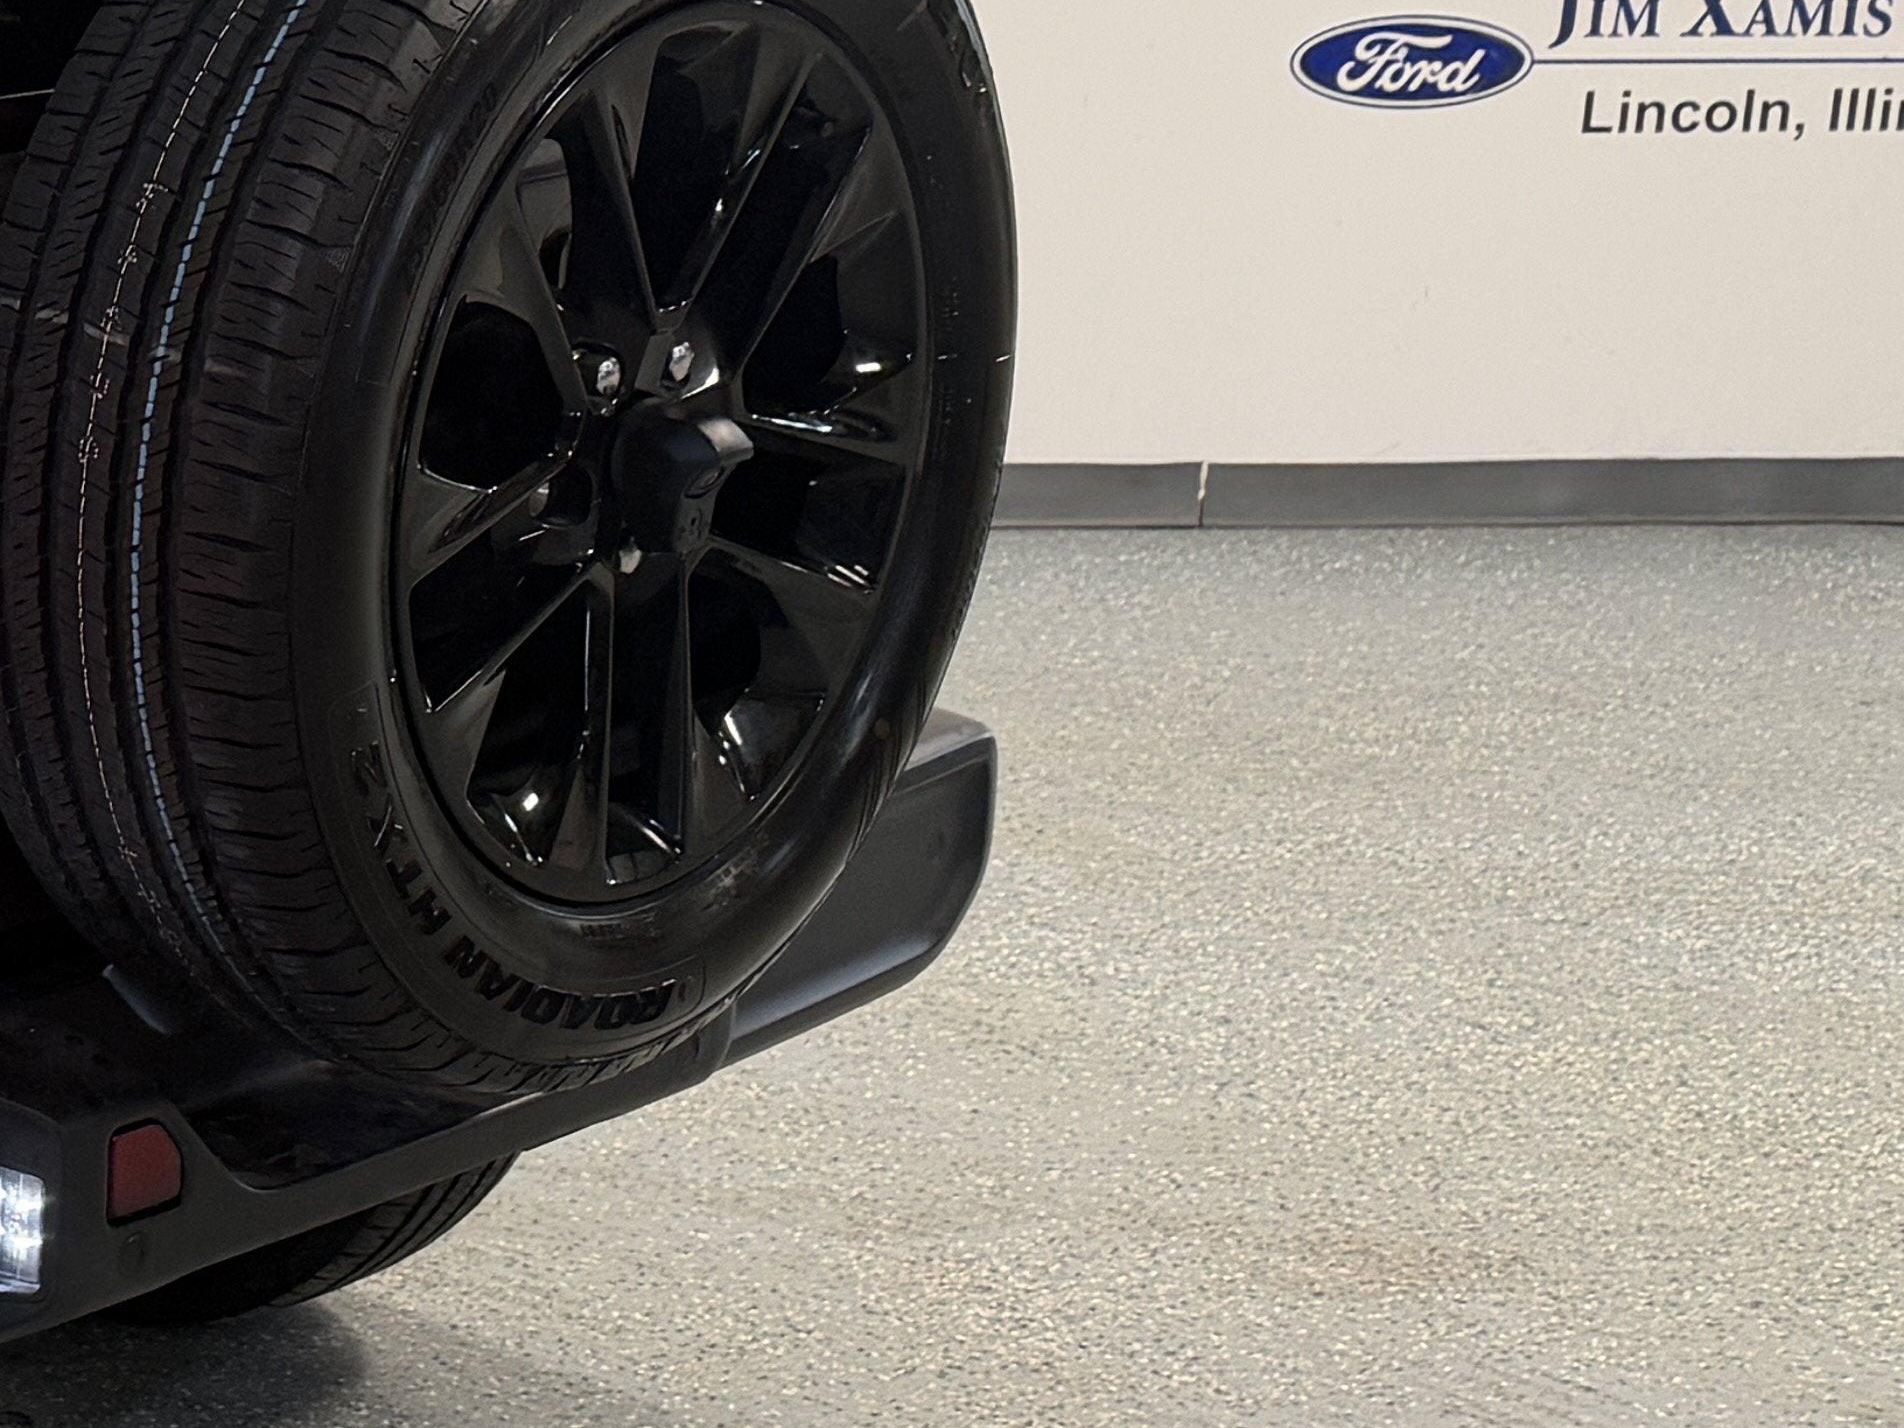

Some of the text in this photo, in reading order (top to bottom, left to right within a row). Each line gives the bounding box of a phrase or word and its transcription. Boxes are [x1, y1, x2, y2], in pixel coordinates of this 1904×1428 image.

[1336, 31, 1486, 92] Ford
[1582, 88, 1904, 140] Lincoln, Illi
[442, 935, 677, 1030] ROADIAN
